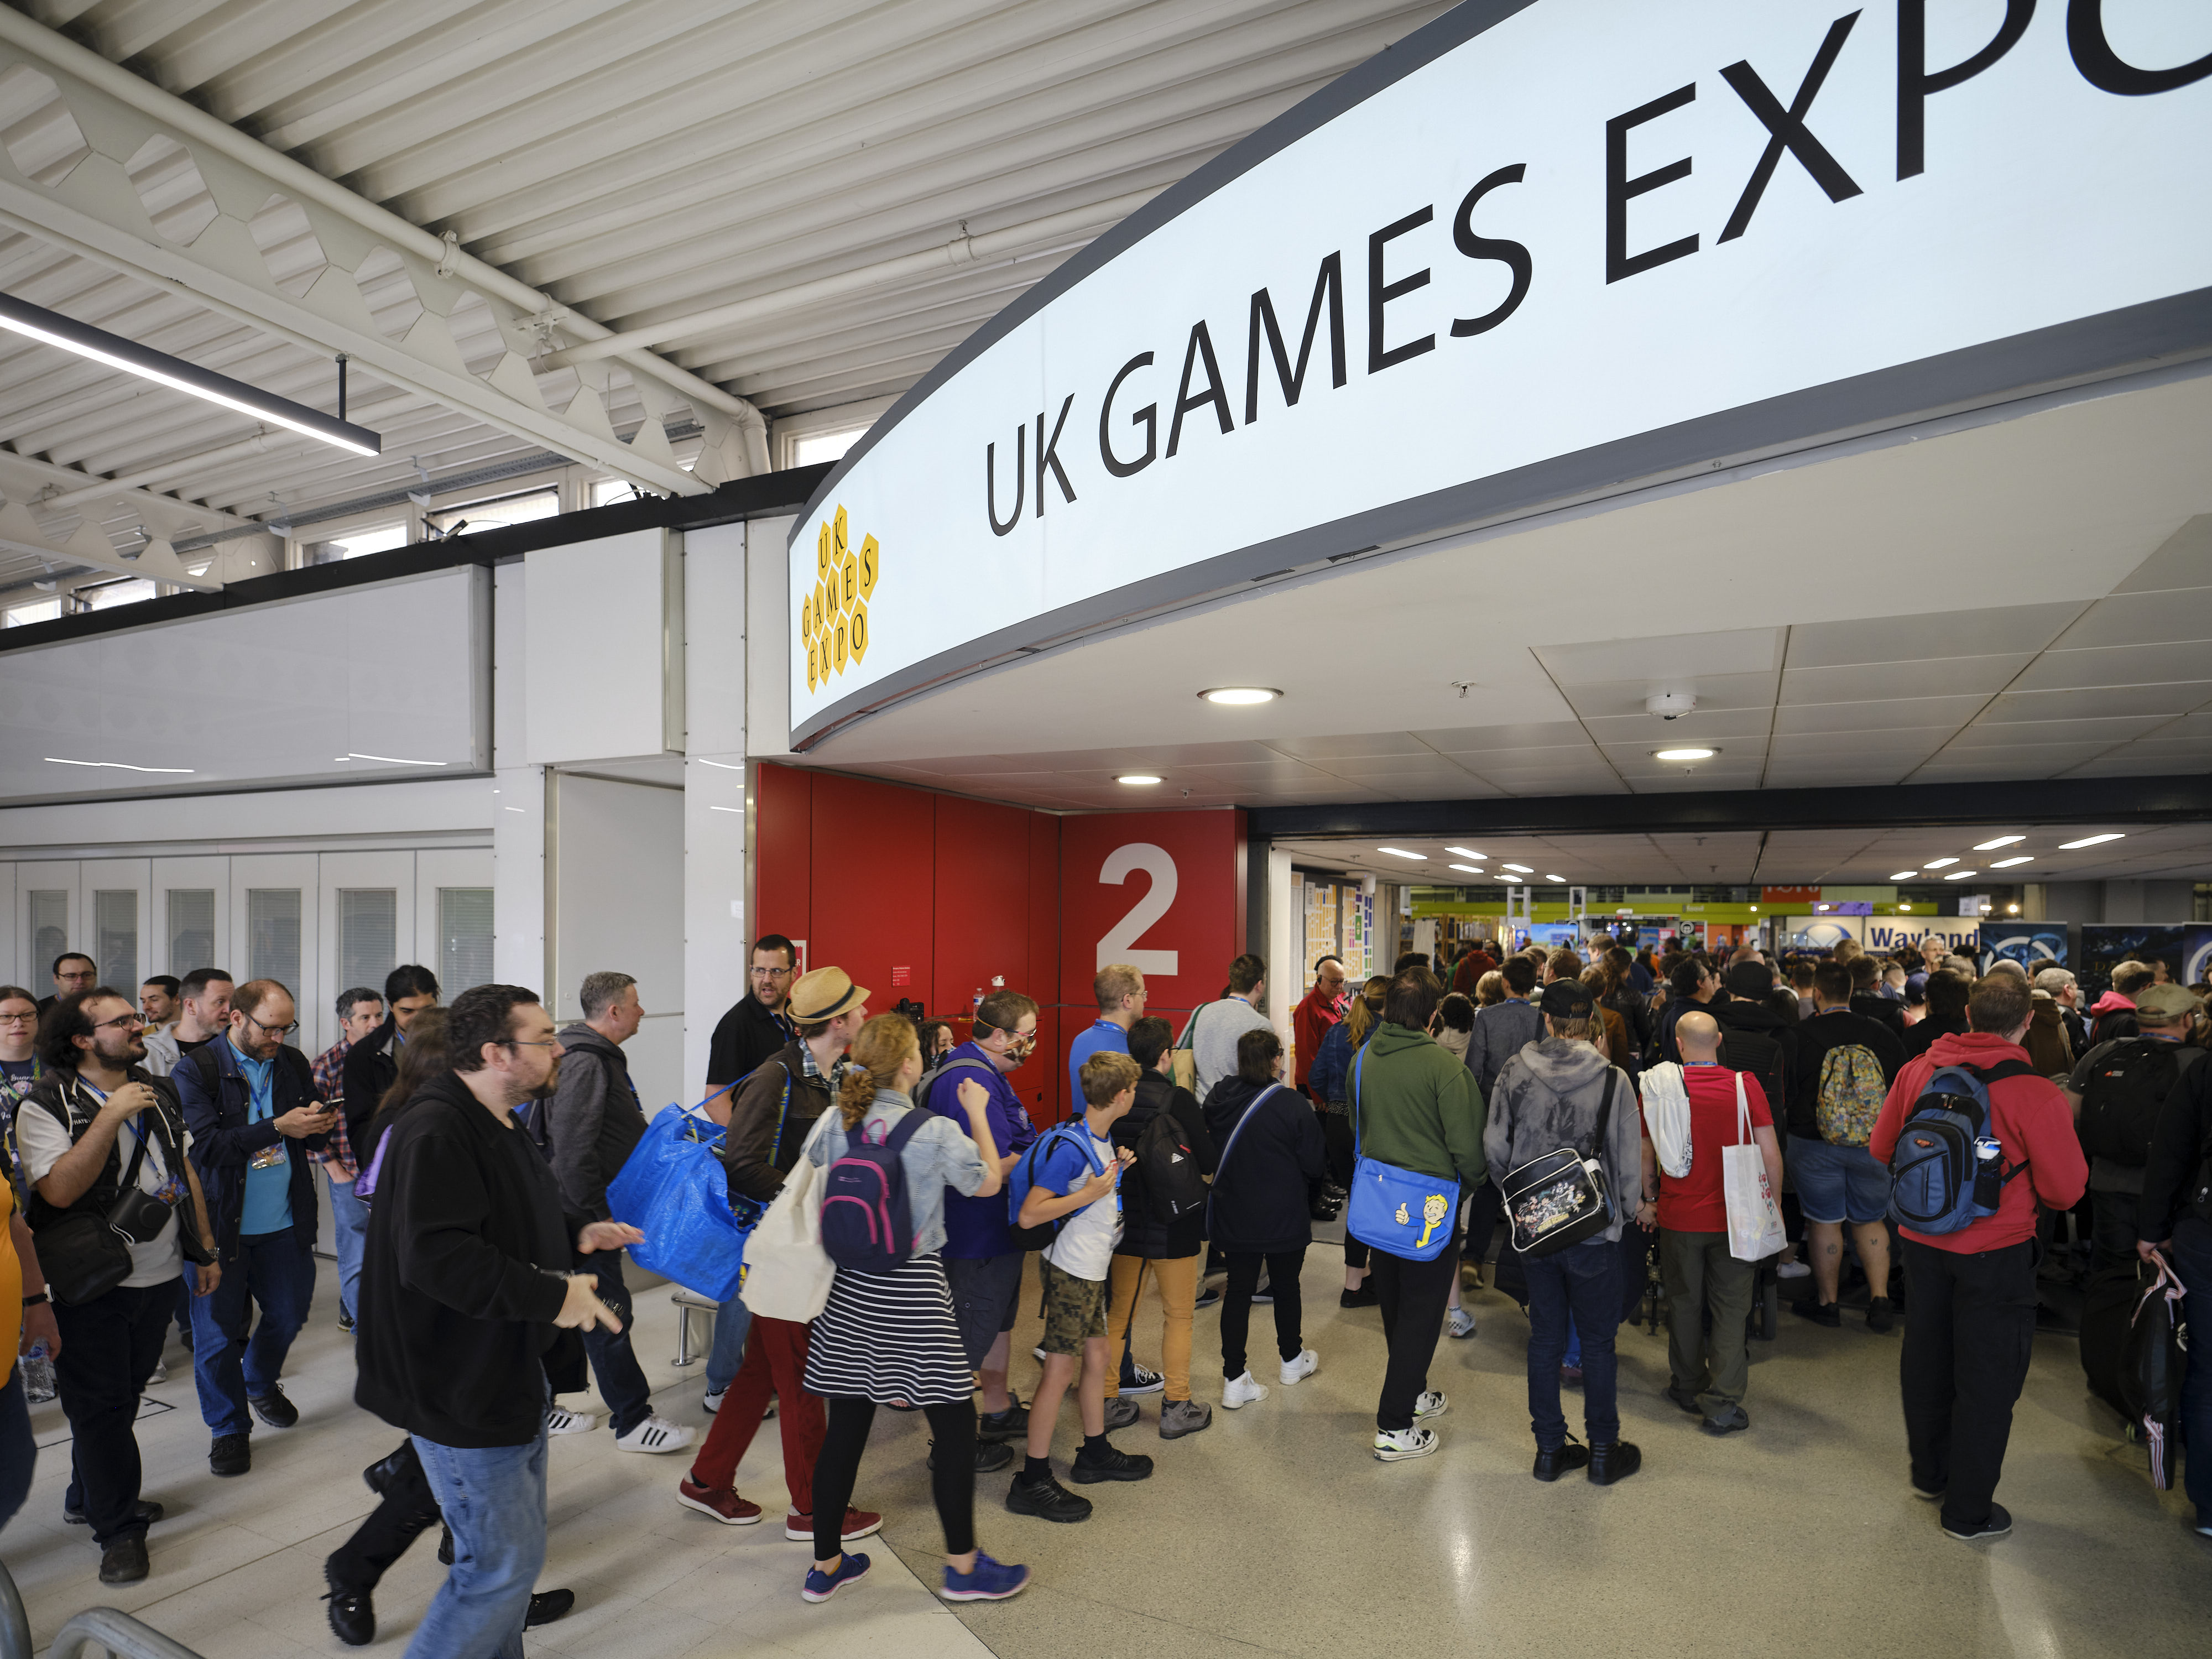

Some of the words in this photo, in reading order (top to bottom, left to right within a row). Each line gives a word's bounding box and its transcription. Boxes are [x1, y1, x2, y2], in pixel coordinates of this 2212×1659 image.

[988, 393, 1077, 536] UK
[1099, 164, 1532, 477] GAMES
[818, 516, 844, 569] UK
[803, 548, 871, 638] GAMES
[810, 613, 864, 682] EXPO
[1097, 842, 1178, 975] 2
